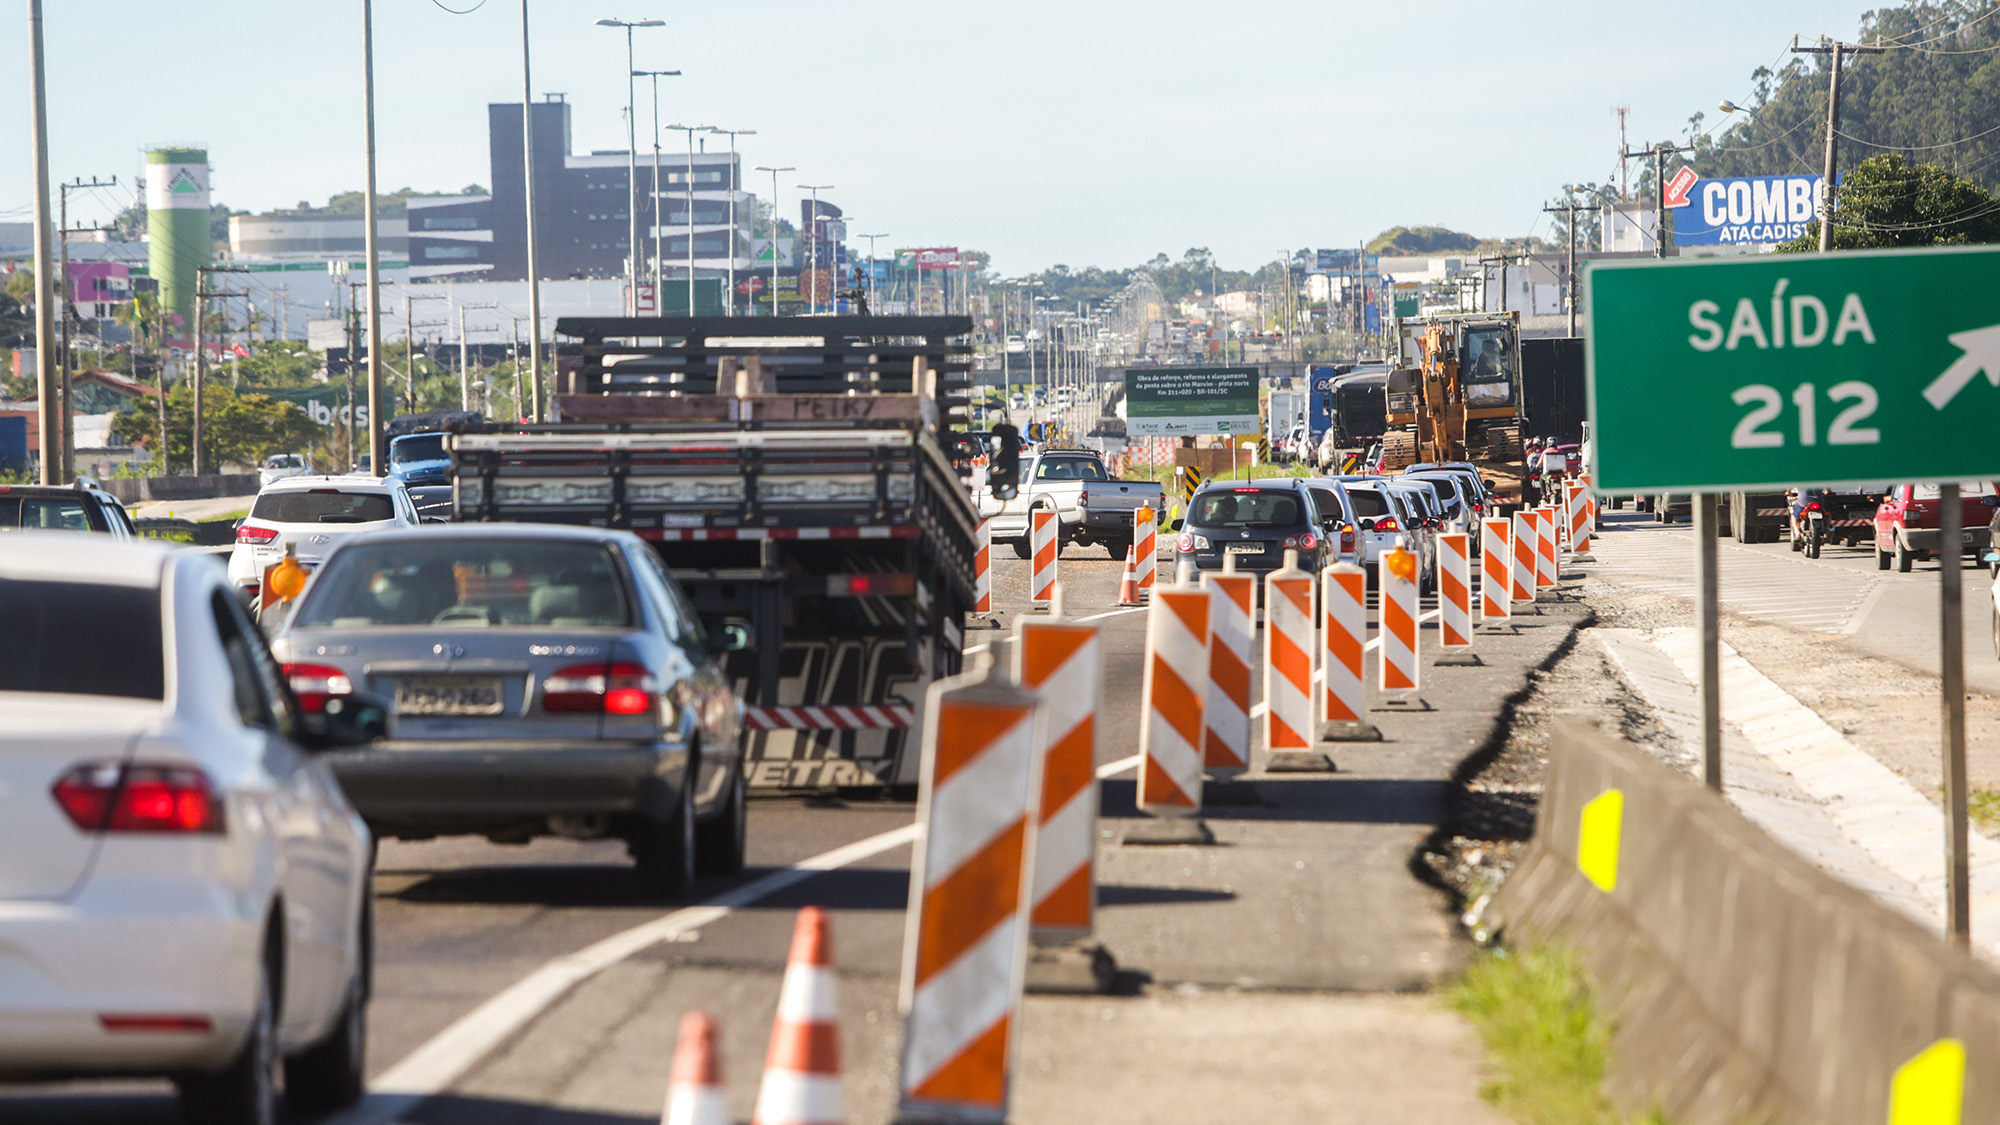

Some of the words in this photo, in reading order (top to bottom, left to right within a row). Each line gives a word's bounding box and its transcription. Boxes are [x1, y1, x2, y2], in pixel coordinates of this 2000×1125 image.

[1668, 172, 1692, 201] ACESSO
[1719, 224, 1810, 242] ATACADIST
[1688, 278, 1876, 352] SAÍDA
[1160, 374, 1182, 382] reforço,
[1211, 373, 1248, 381] alargamento
[1218, 380, 1232, 388] pista
[1731, 380, 1881, 449] 212
